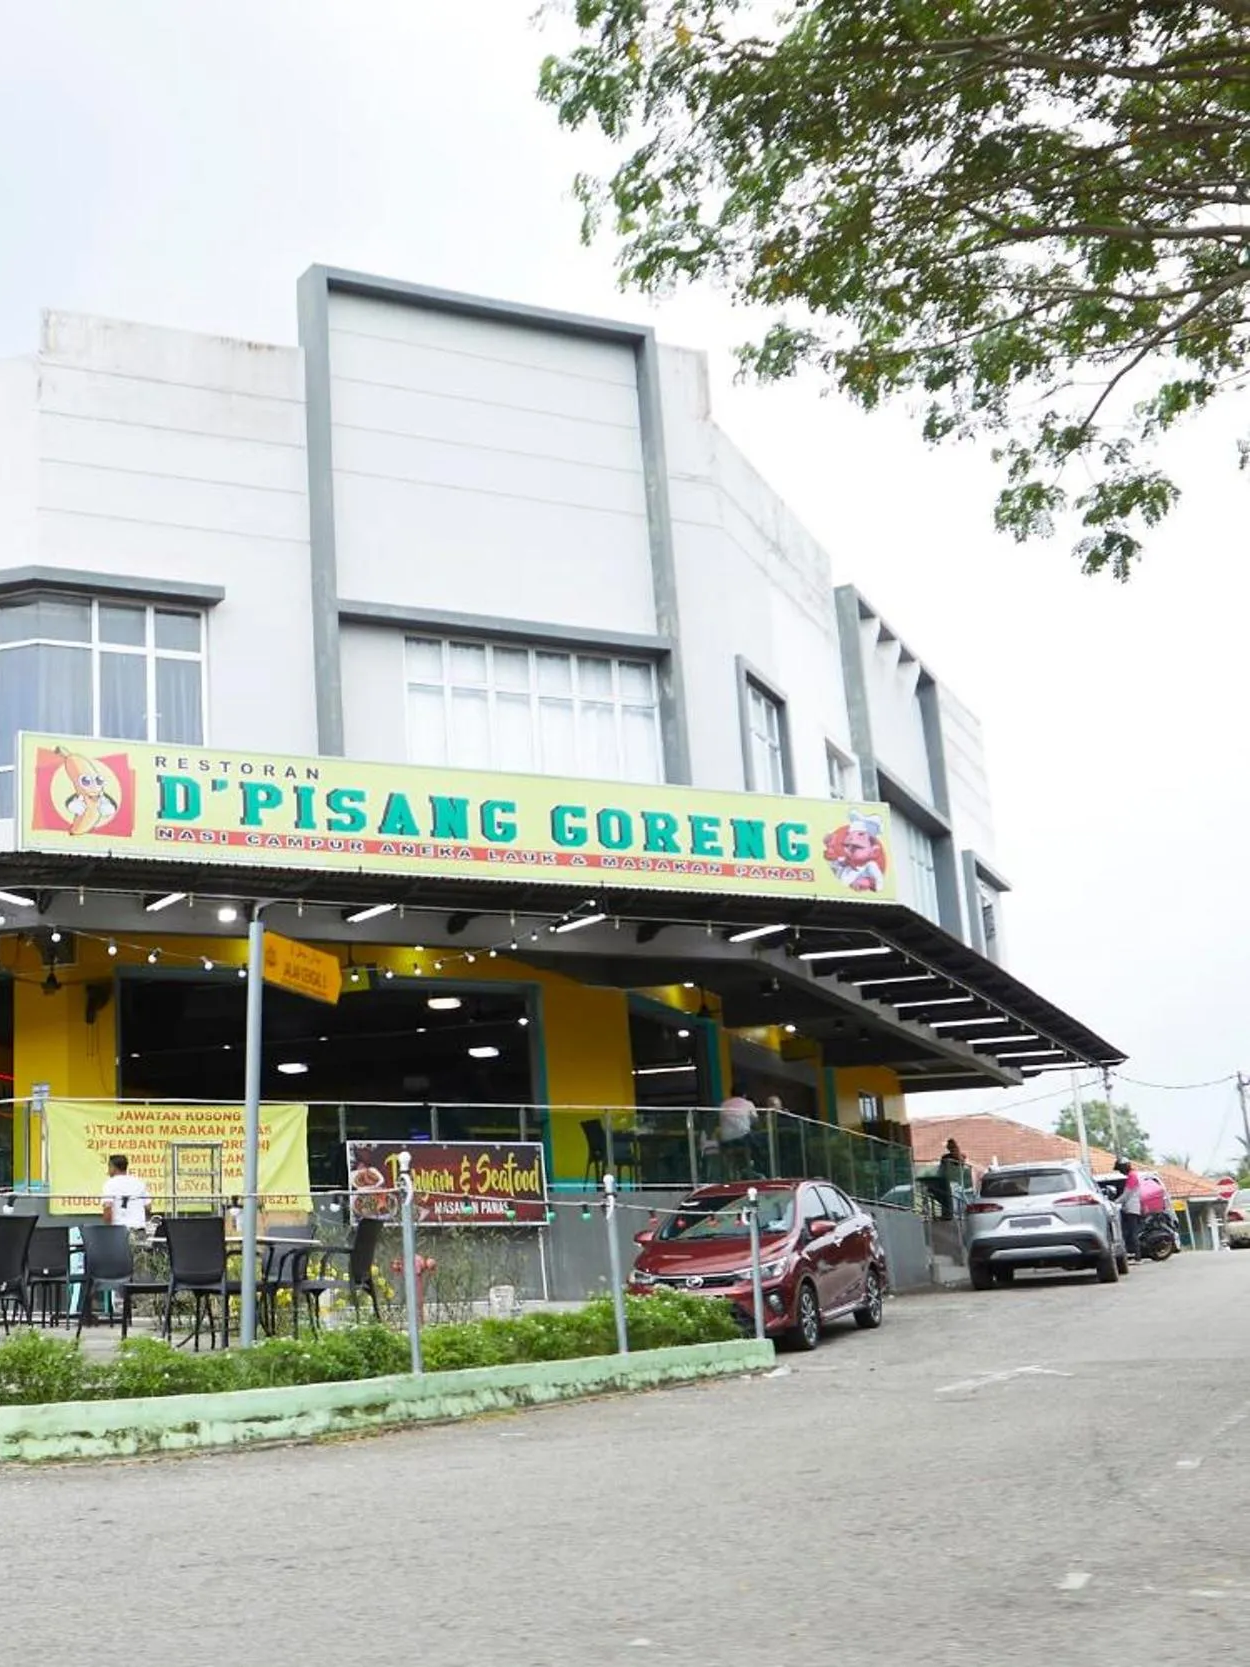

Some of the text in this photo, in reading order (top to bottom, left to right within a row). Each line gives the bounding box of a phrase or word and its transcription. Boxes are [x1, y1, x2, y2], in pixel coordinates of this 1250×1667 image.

[154, 755, 321, 780] RESTORAN
[156, 774, 811, 863] D'PISANG GORENG
[159, 828, 815, 882] NASI CAMPUR ANEKA LAUK & MASAKAN PANAS
[116, 1111, 242, 1122] JAWATAN KOSONG
[159, 1124, 226, 1136] MASAKAN
[459, 1155, 471, 1197] &
[476, 1152, 541, 1197] Seafood
